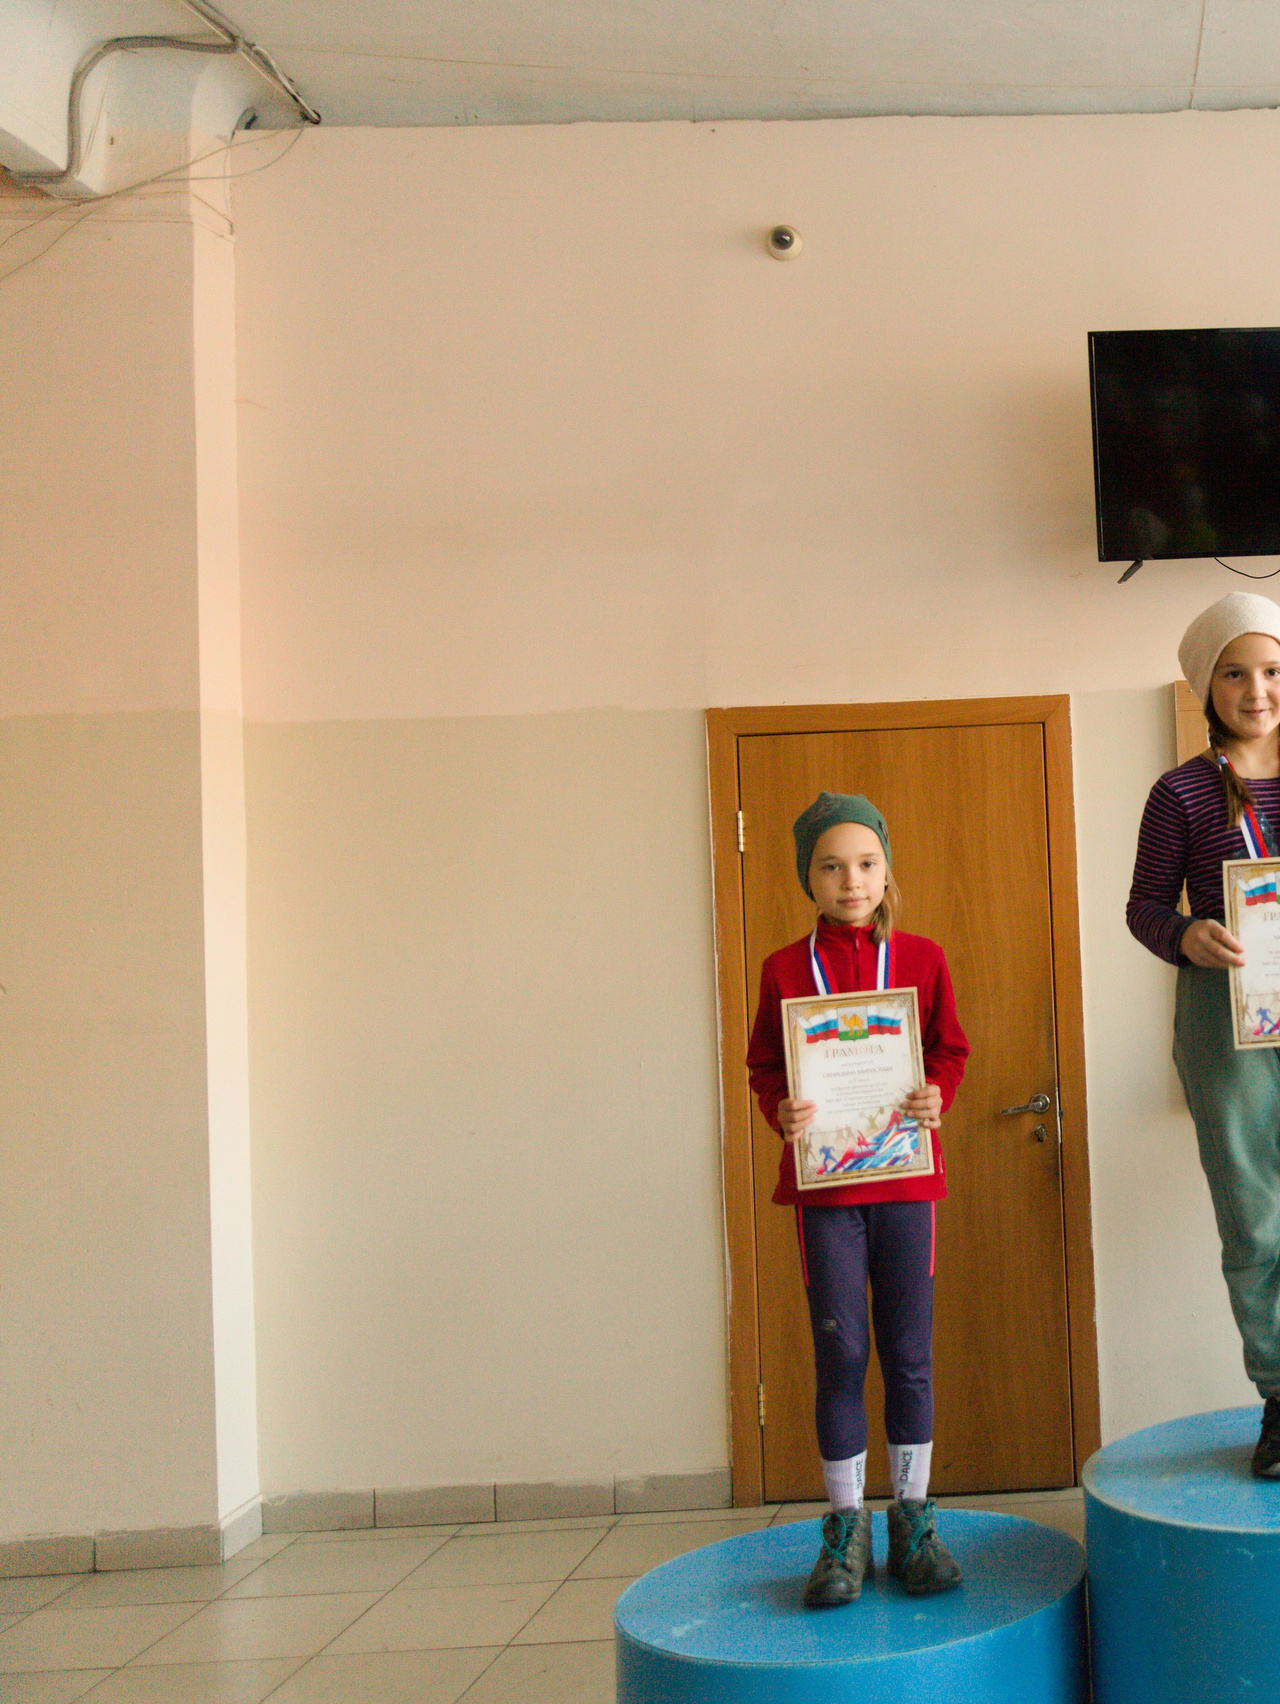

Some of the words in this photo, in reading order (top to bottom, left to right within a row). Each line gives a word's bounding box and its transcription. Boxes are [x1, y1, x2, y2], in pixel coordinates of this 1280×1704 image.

[824, 1044, 885, 1058] ГРАМОТА
[856, 1458, 864, 1489] DANCE
[900, 1450, 912, 1482] DANCE
